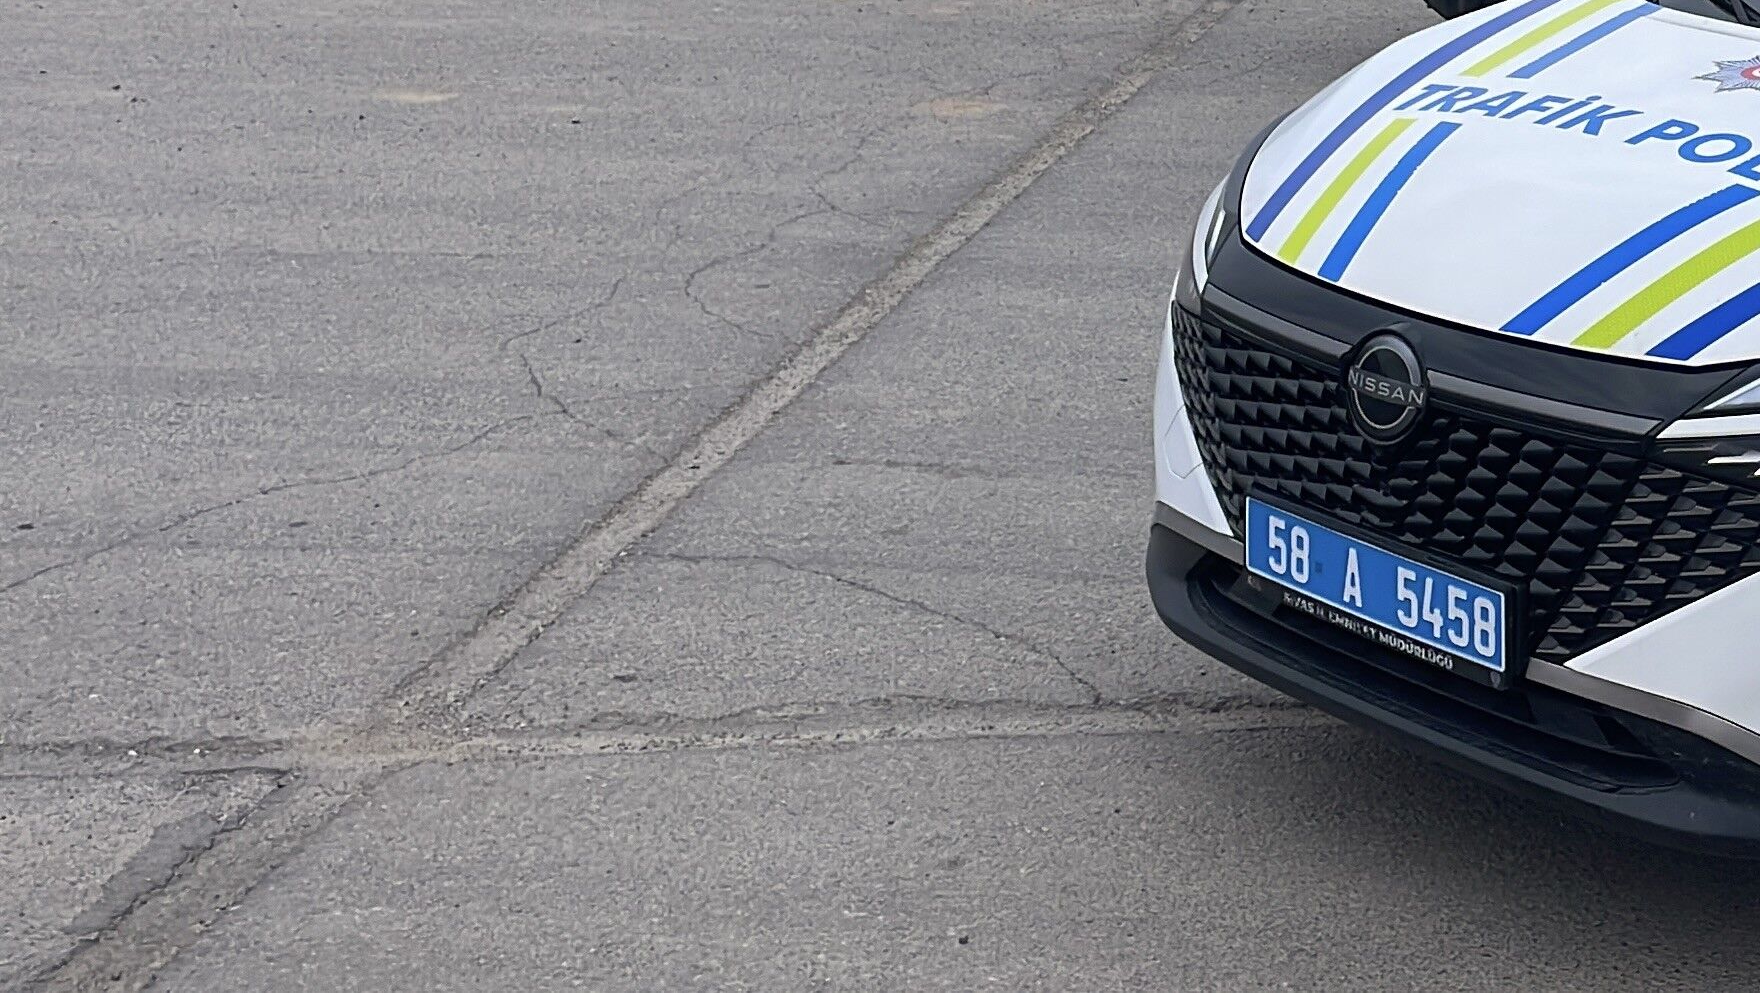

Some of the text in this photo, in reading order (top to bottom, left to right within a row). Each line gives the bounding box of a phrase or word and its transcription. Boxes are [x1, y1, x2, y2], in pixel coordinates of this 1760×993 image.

[1393, 84, 1644, 136] TRAFİK
[1349, 369, 1425, 405] NISSAN
[1268, 515, 1497, 658] 58 A 5458
